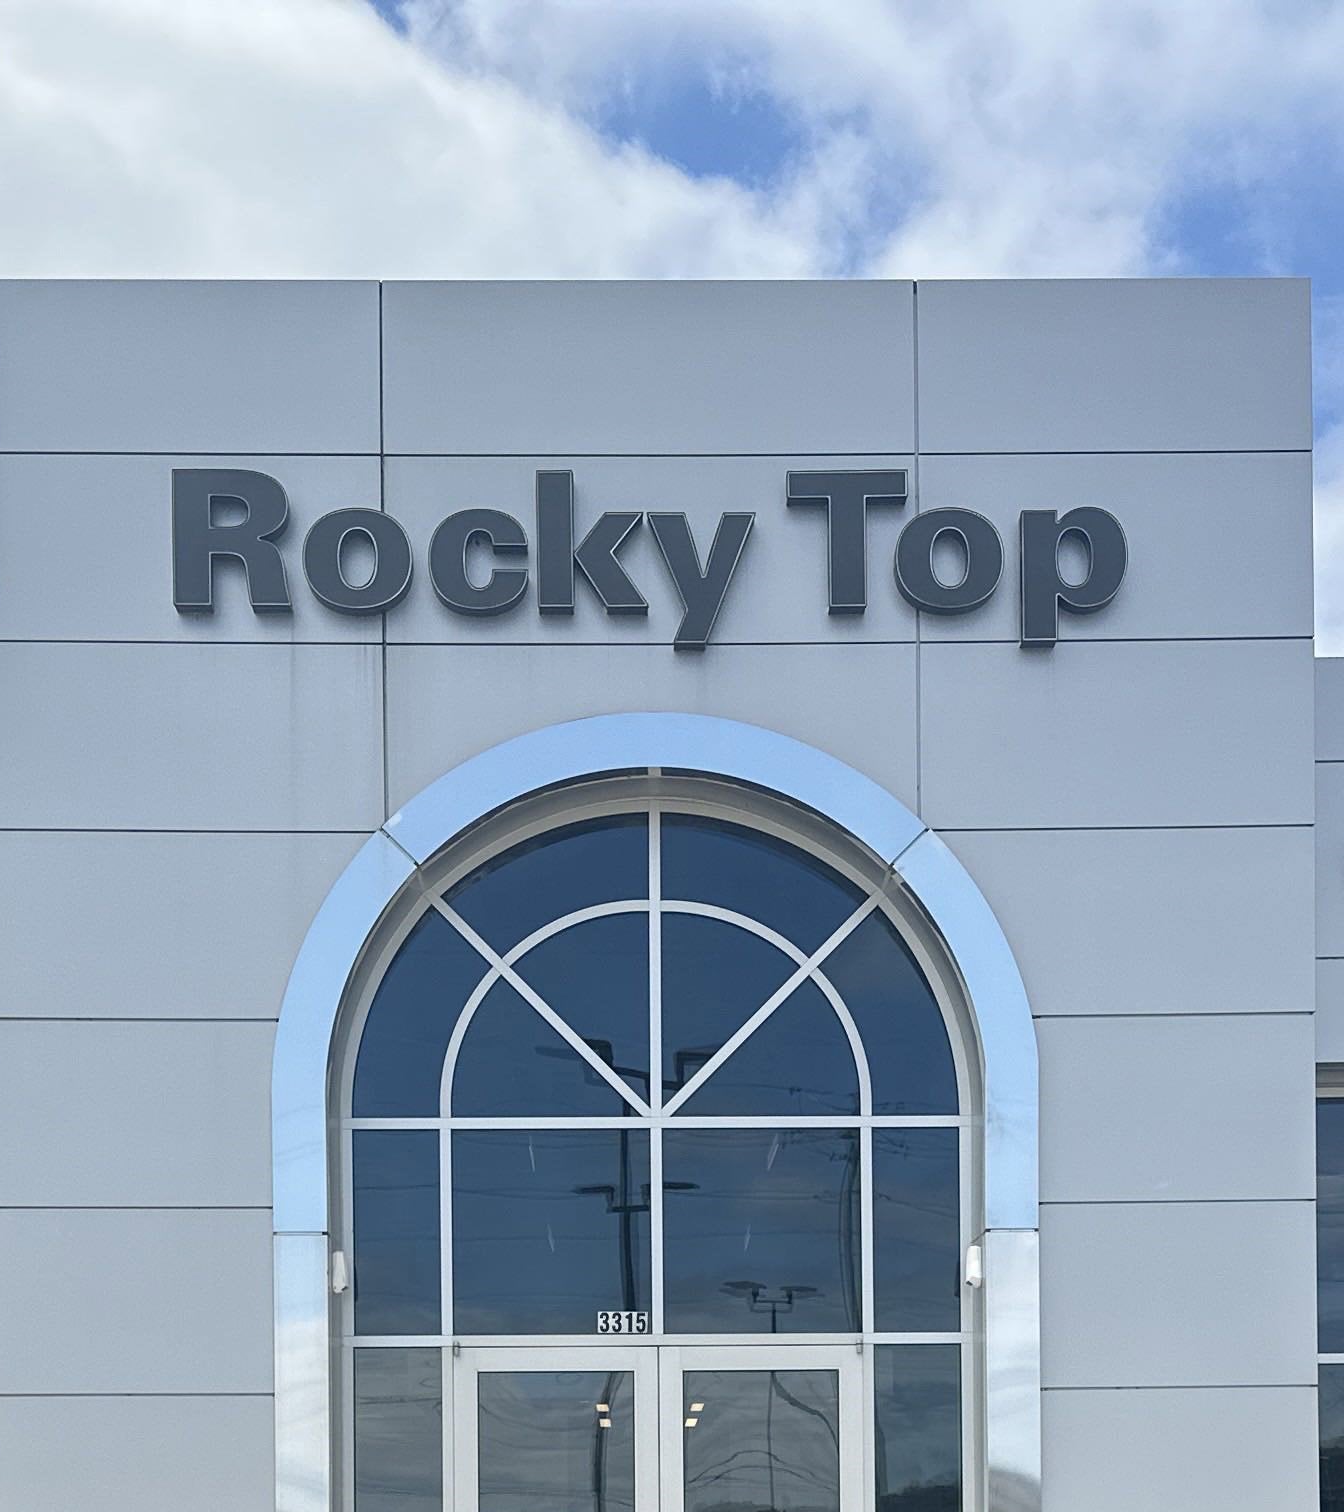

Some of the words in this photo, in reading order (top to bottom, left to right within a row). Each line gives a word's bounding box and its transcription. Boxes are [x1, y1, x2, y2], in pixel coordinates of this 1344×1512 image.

[170, 468, 756, 652] Rocky
[786, 470, 1129, 649] Top
[599, 1312, 647, 1333] 3315
